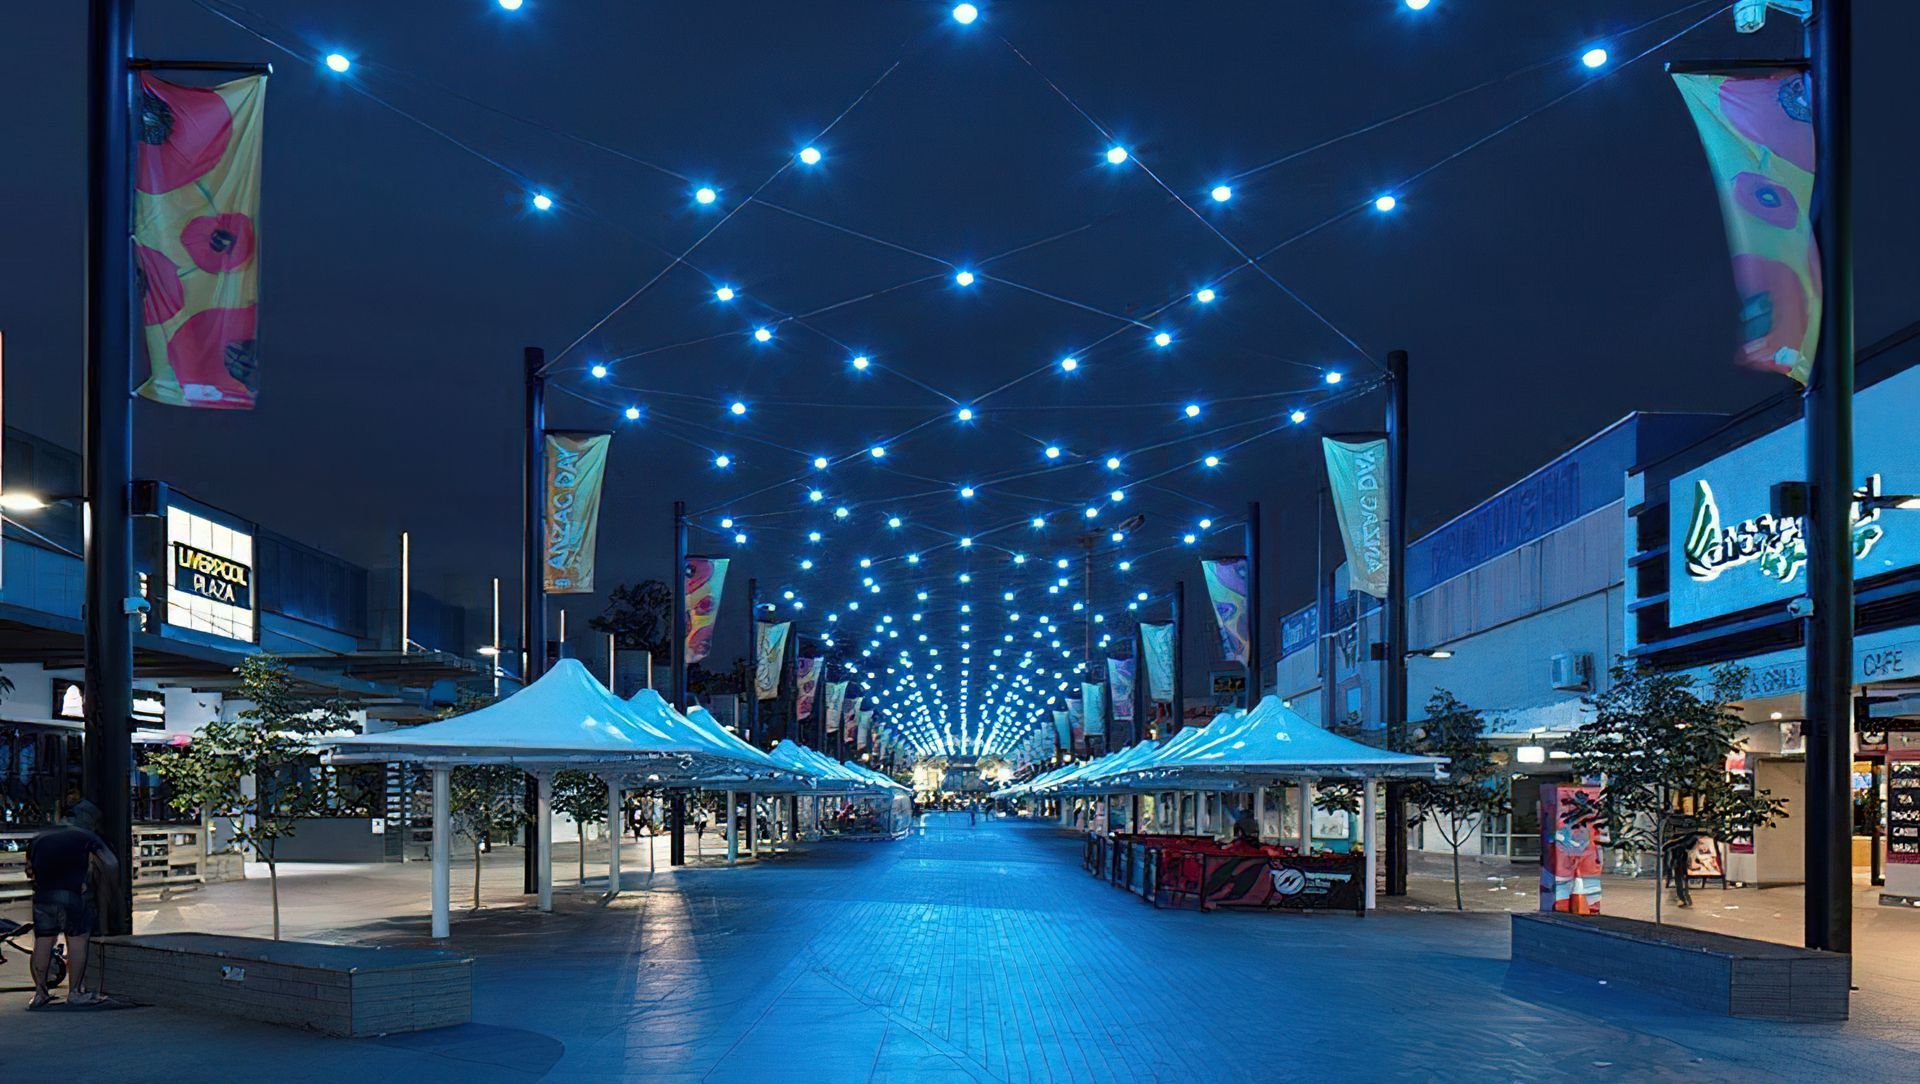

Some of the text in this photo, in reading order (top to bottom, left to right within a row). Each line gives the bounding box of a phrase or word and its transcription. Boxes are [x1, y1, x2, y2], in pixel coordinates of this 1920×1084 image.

[553, 447, 579, 488] DAY
[547, 492, 574, 570] ANZAC
[178, 546, 248, 587] LIVERPOOL
[193, 573, 236, 603] PLAZA
